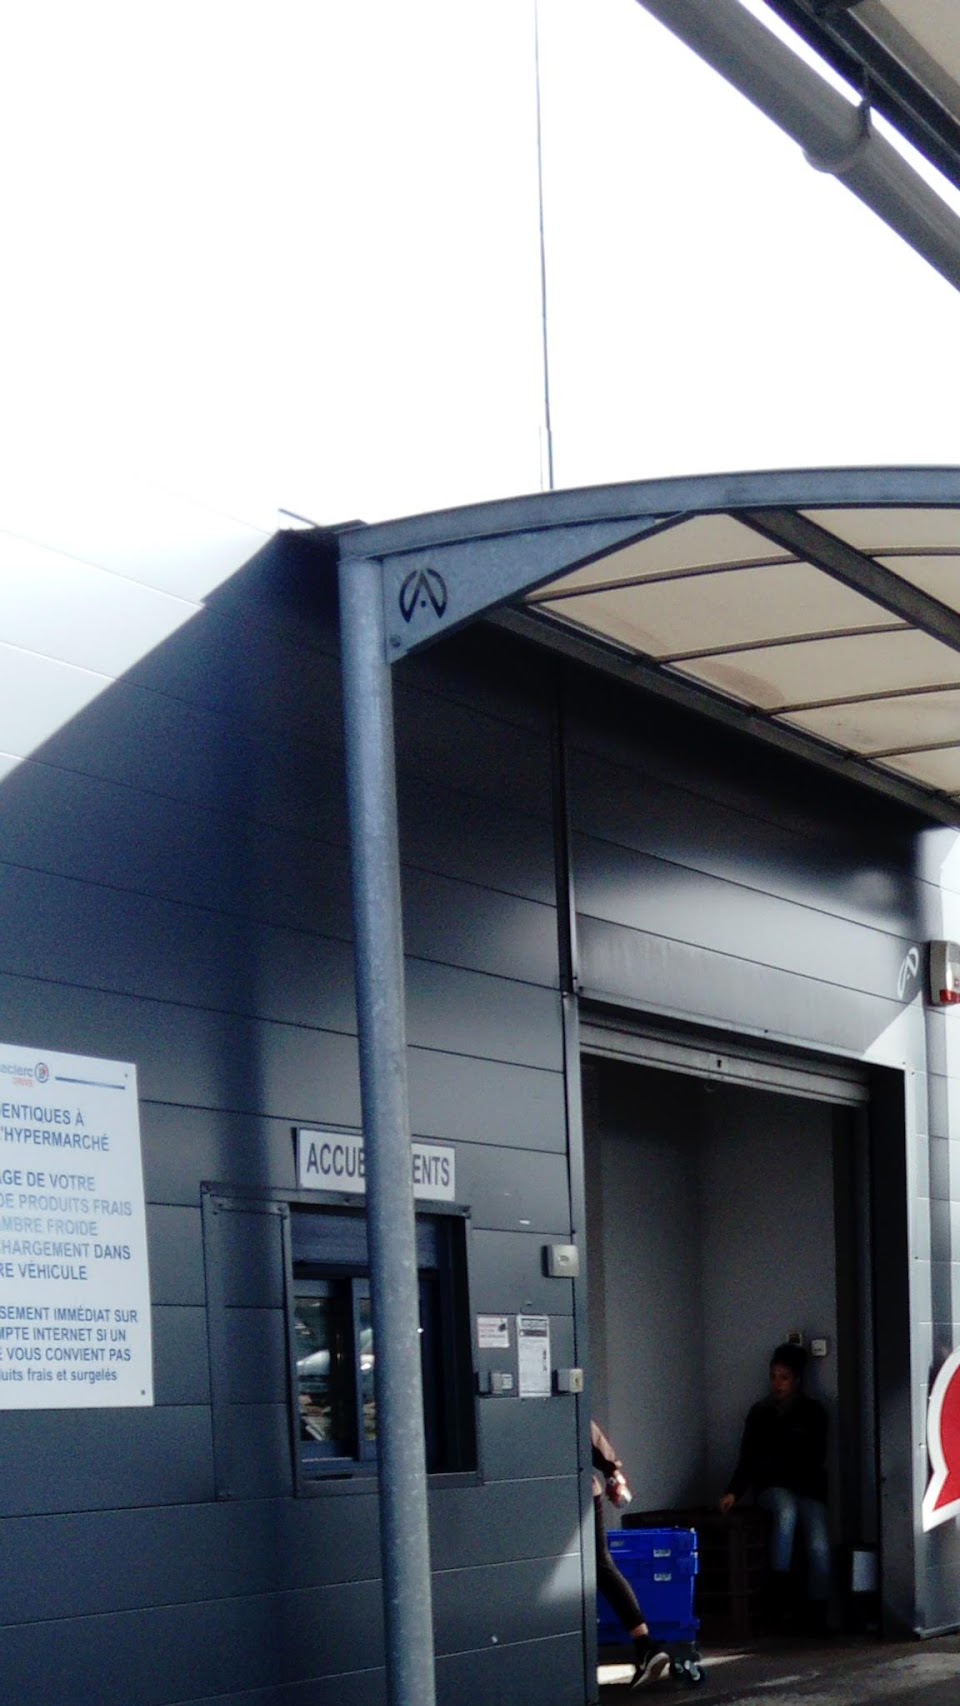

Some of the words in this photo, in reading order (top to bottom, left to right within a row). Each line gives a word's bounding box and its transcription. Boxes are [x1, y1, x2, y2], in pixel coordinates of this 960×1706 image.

[0, 1063, 33, 1077] eclerc
[0, 1103, 71, 1125] ENTIQUES
[75, 1108, 85, 1127] À
[0, 1126, 109, 1151] 'HYPERMARCHÉ
[307, 1142, 366, 1178] ACCUE
[412, 1154, 450, 1187] ENTS
[0, 1169, 22, 1186] GE
[27, 1171, 46, 1188] DE
[49, 1173, 96, 1192] VOTRE
[19, 1194, 89, 1214] PRODUITS
[93, 1199, 133, 1217] FRAIS
[0, 1216, 42, 1233] MBRE
[47, 1219, 98, 1237] FROIDE
[0, 1240, 90, 1258] HARGEMENT
[94, 1244, 131, 1261] DANS
[18, 1260, 88, 1281] VÉHICULE
[54, 1305, 110, 1322] IMMÉDIAT
[114, 1309, 139, 1323] SUR
[33, 1327, 92, 1342] INTERNET
[96, 1328, 107, 1342] SI
[110, 1329, 127, 1342] UN
[6, 1347, 41, 1361] VOUS
[45, 1346, 106, 1361] CONVIENT
[109, 1348, 132, 1361] PAS
[27, 1367, 53, 1381] frais
[56, 1367, 68, 1381] et
[70, 1367, 118, 1385] surgelés
